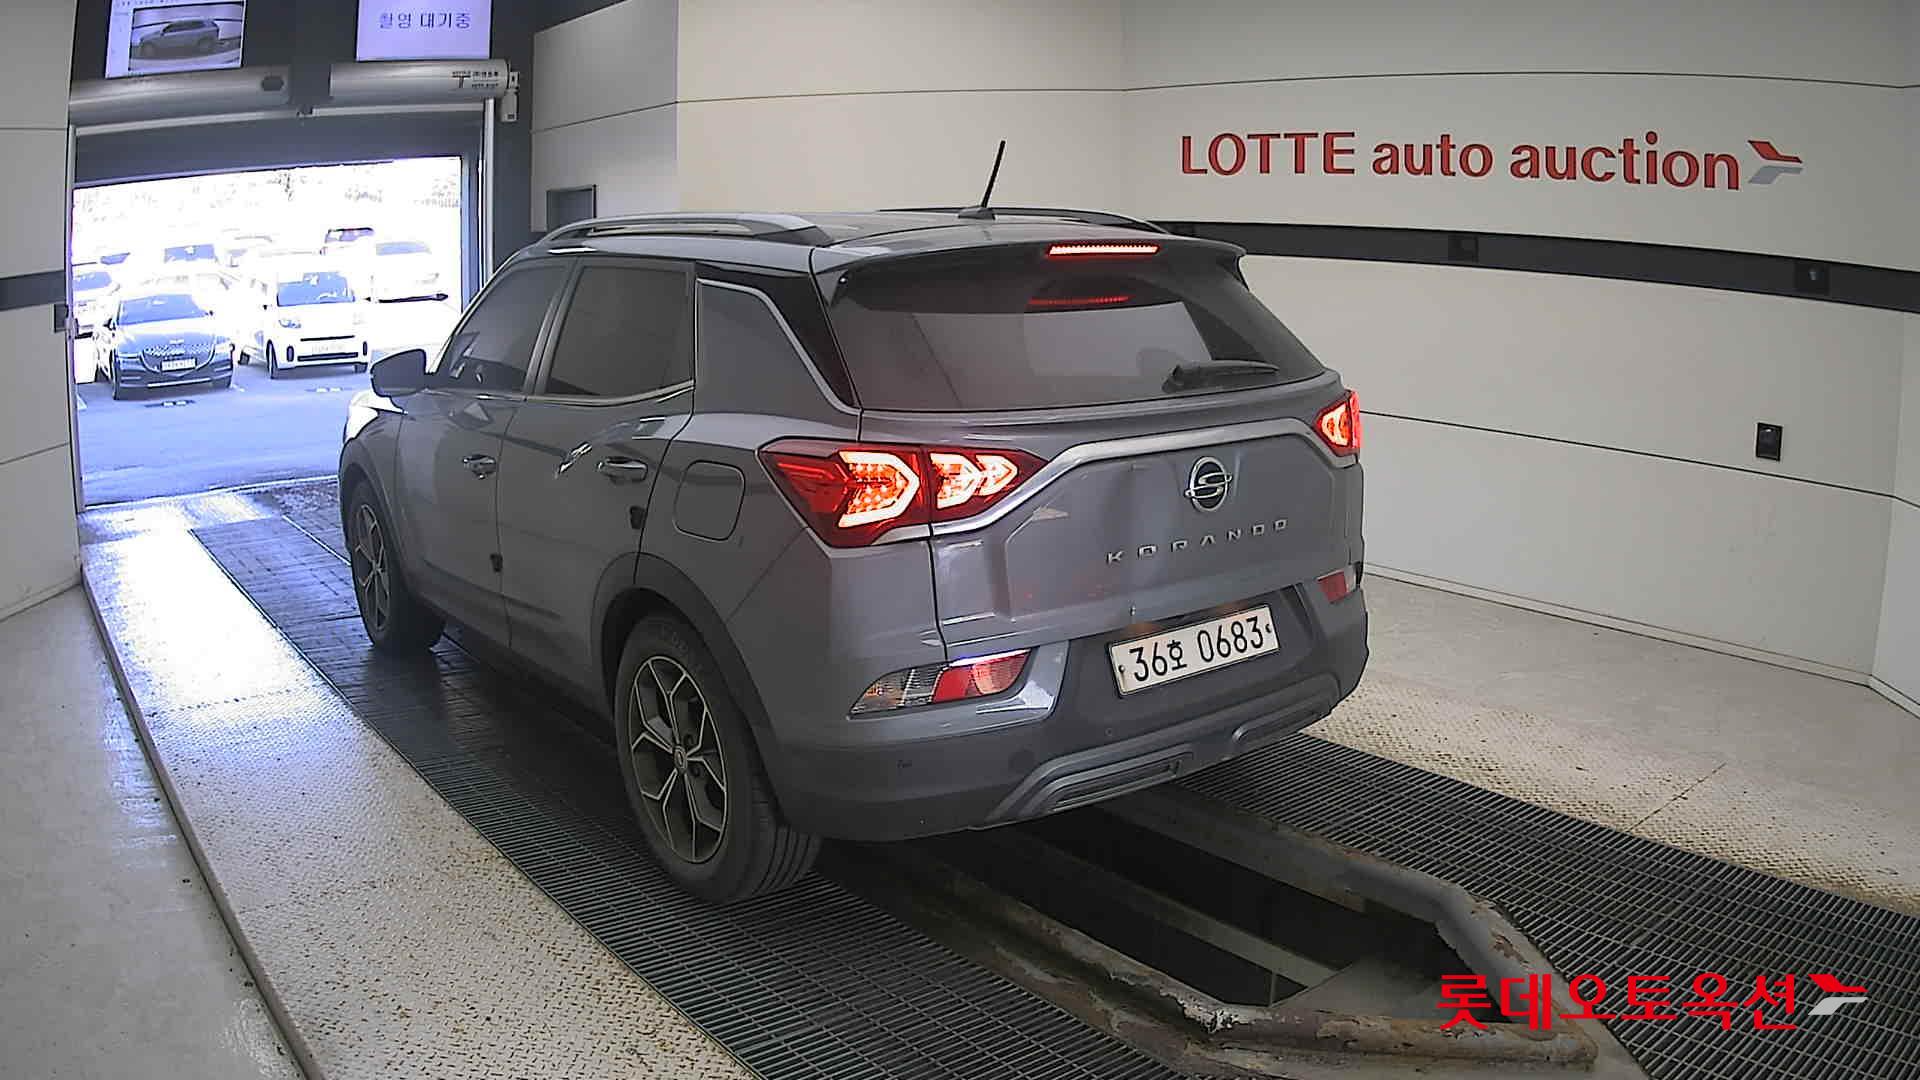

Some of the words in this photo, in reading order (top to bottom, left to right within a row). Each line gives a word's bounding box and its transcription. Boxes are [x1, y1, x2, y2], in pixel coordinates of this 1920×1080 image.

[420, 12, 471, 29] 대기중
[1180, 131, 1356, 176] LOTTE
[1371, 133, 1494, 178] auto
[1509, 131, 1740, 190] auction
[1106, 518, 1288, 565] KORANDO
[1129, 639, 1187, 682] 36호
[1197, 616, 1264, 663] 0683
